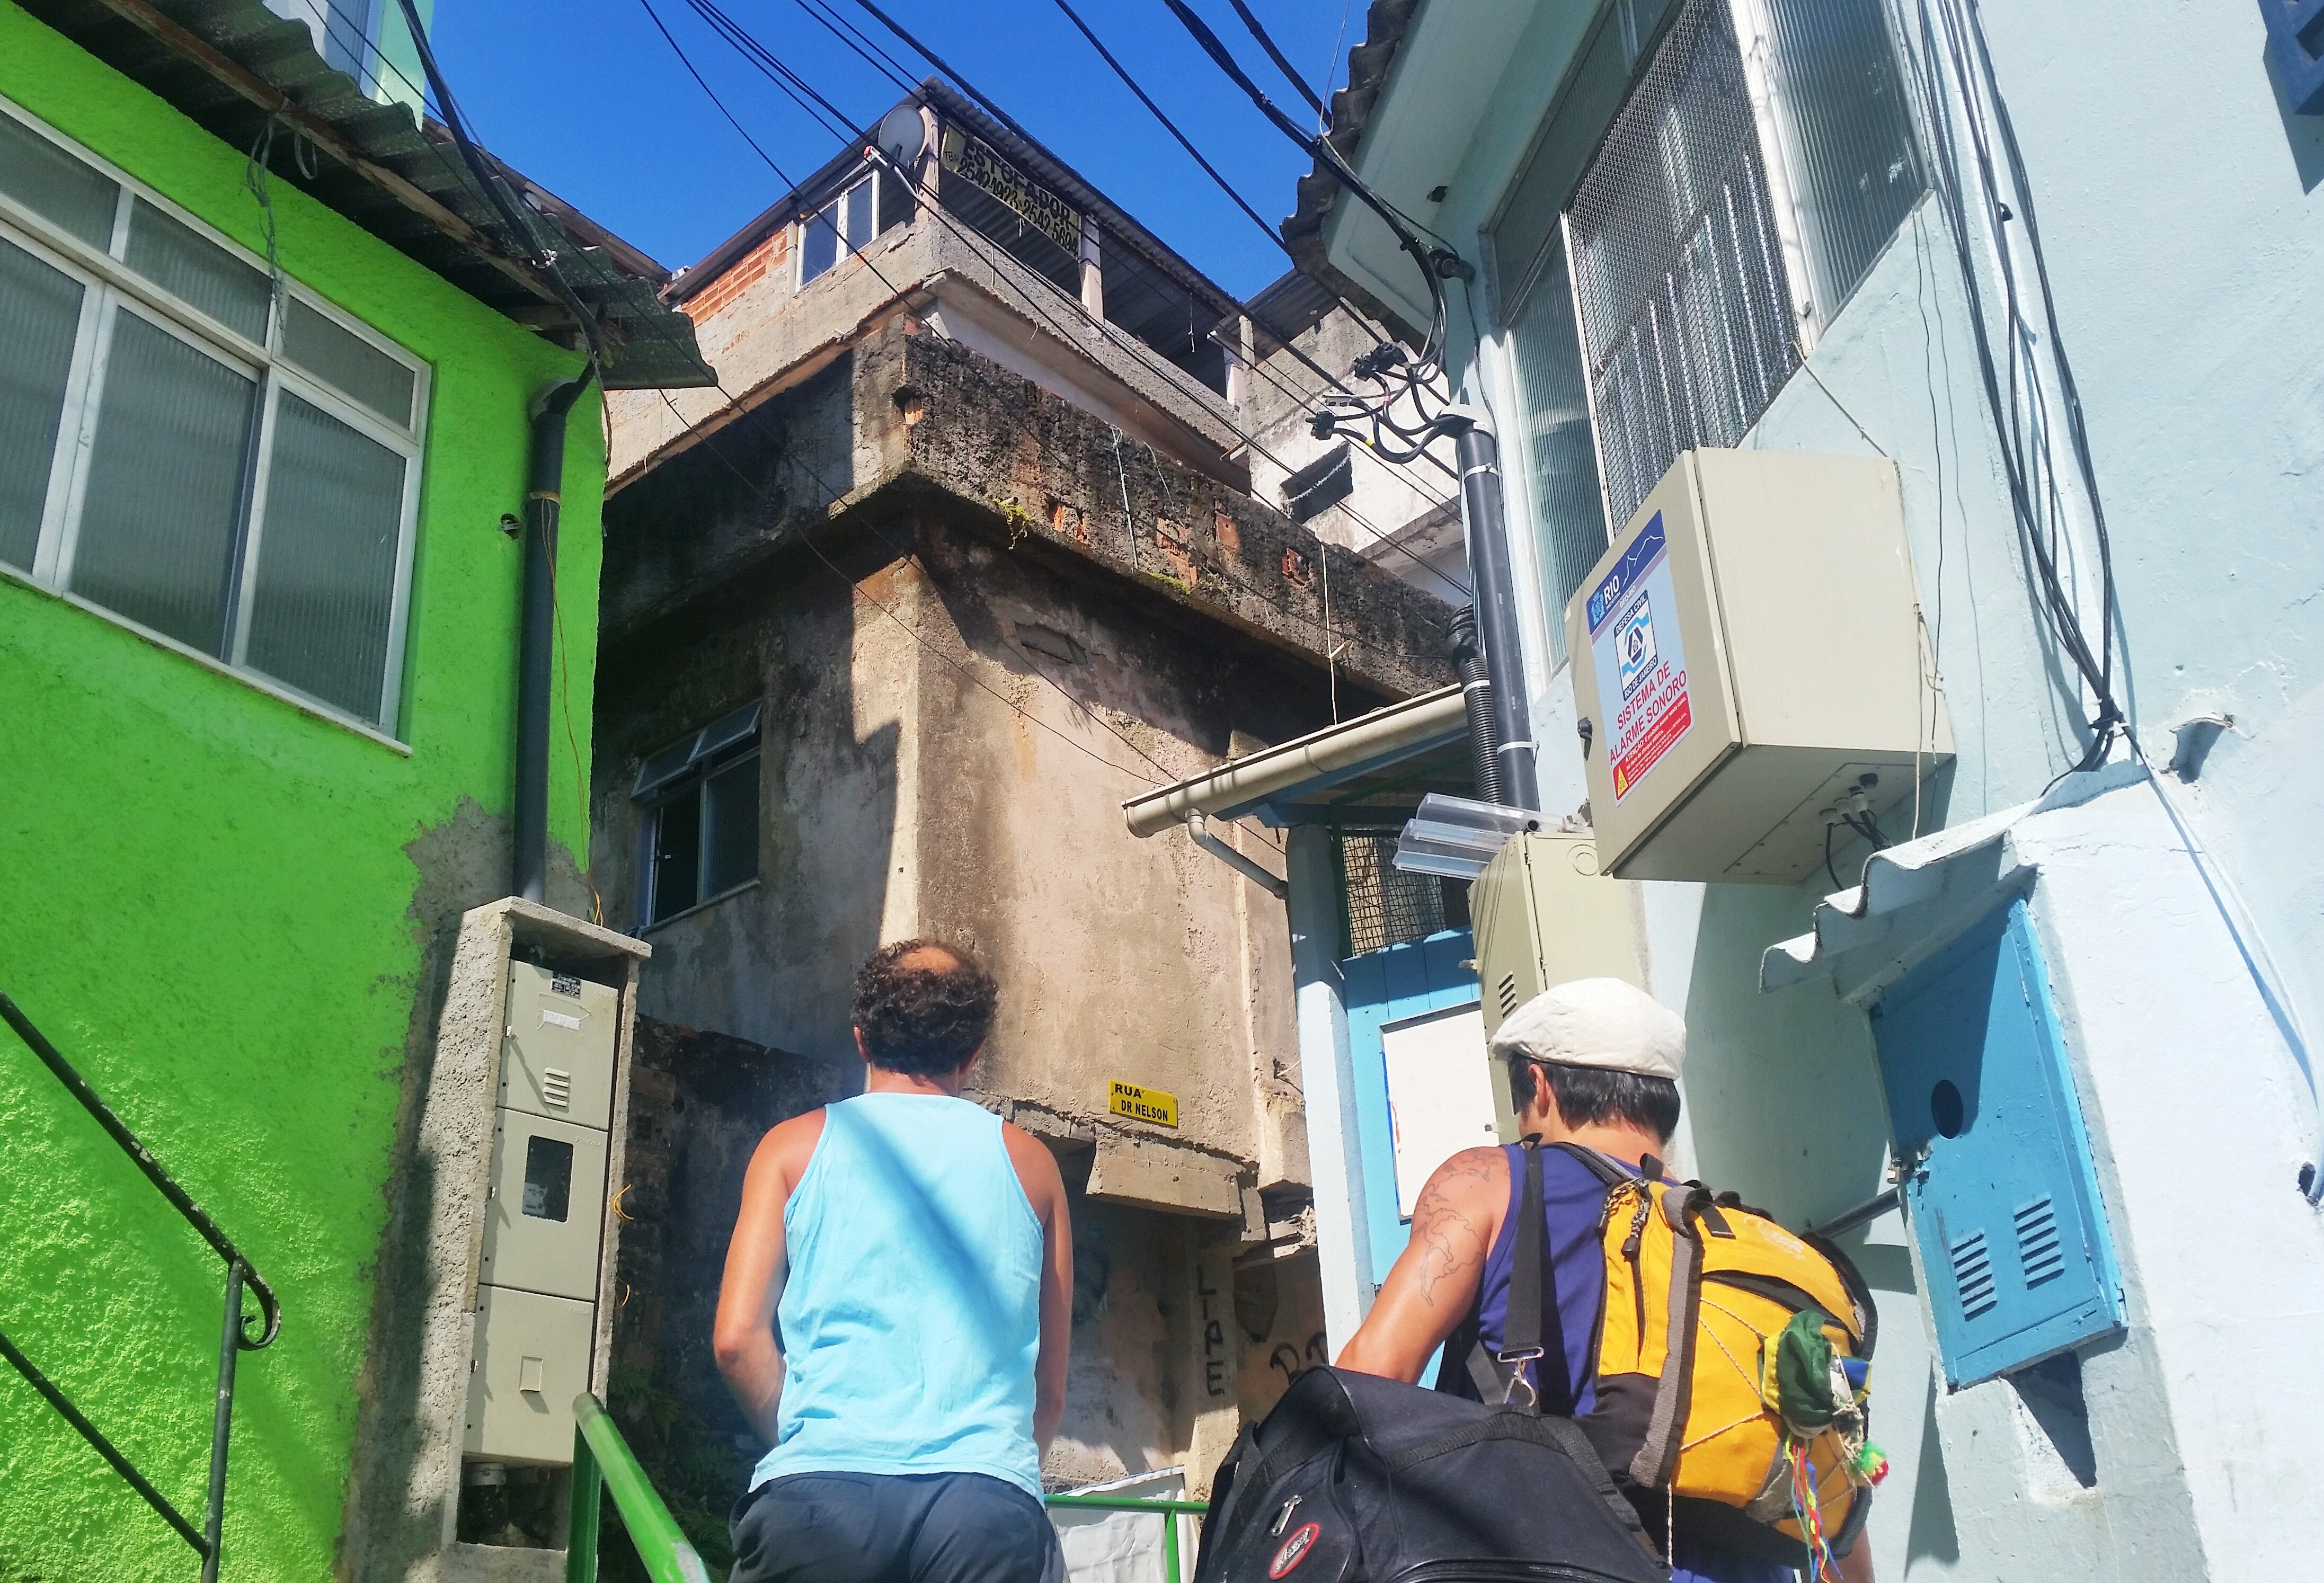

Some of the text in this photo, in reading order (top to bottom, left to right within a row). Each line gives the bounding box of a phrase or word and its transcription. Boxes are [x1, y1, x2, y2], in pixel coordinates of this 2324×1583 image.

[963, 139, 1070, 231] ESTOFADOR
[1603, 575, 1619, 603] RIO
[1620, 585, 1636, 608] GEO-RIO
[1616, 594, 1646, 634] DEFESA CIVIL
[1632, 678, 1639, 689] DE
[1638, 657, 1656, 682] JANEIRO
[1617, 679, 1656, 730] SISTEMA
[1657, 661, 1670, 686] DE
[1609, 715, 1645, 765] ALARME
[1646, 670, 1686, 723] SONORO
[1625, 739, 1645, 762] ATENÇÃO:
[1115, 1083, 1142, 1099] RUA
[1121, 1100, 1168, 1122] DR NELSON
